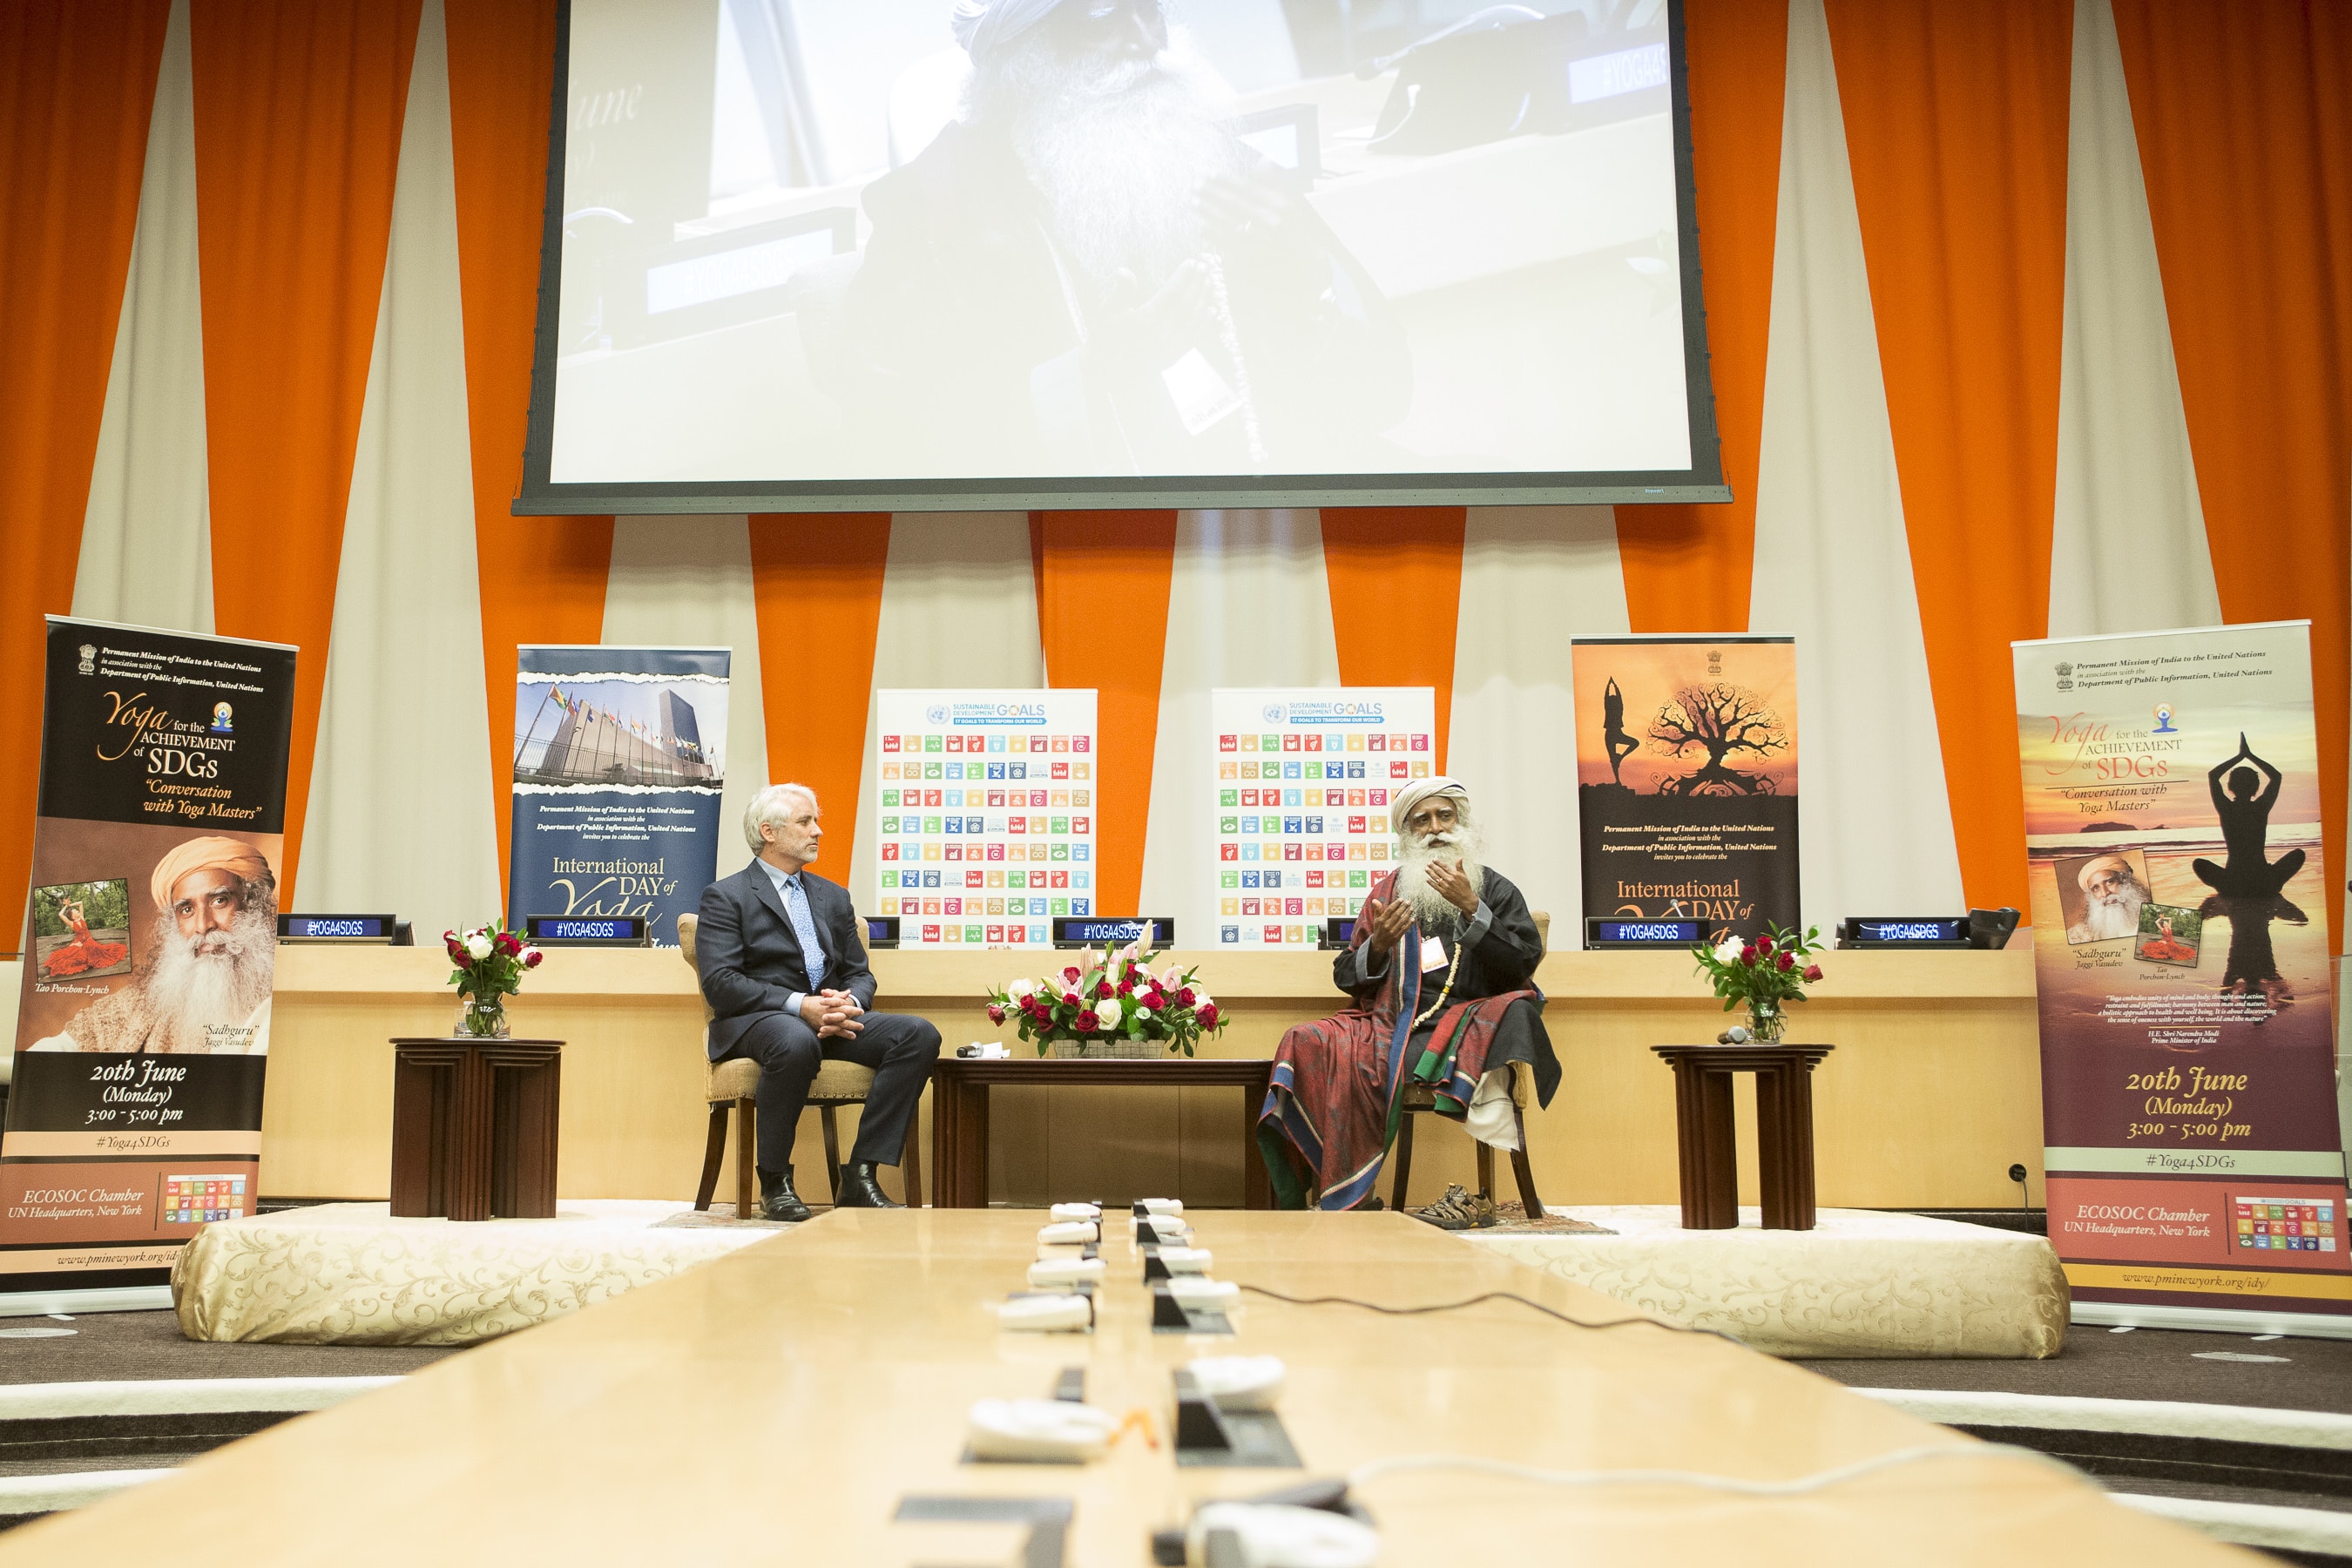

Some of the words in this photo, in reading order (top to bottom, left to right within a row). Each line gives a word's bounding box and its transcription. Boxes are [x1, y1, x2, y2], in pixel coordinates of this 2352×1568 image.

[576, 84, 641, 131] une
[102, 647, 139, 657] Permanent
[139, 652, 166, 660] Mission
[174, 655, 194, 664] India
[235, 663, 261, 672] Nations
[100, 668, 141, 678] Department
[172, 676, 214, 687] Information,
[2078, 679, 2123, 688] Department
[2160, 673, 2210, 683] Information,
[997, 705, 1044, 716] GOALS
[1334, 703, 1382, 714] GOALS
[97, 692, 173, 760] Yoga
[174, 720, 188, 731] for
[190, 721, 204, 733] the
[140, 732, 235, 751] ACHIEVEMENT
[2045, 712, 2115, 775] Yoga
[2117, 729, 2130, 739] for
[2132, 729, 2147, 738] the
[2085, 740, 2182, 754] ACHIEVEMENT
[134, 747, 144, 757] of
[148, 748, 218, 778] SDGs
[2083, 760, 2092, 770] of
[2097, 755, 2168, 780] SDGs
[2140, 785, 2167, 795] with
[144, 800, 173, 813] with
[178, 801, 206, 819] Yoga
[2079, 802, 2103, 815] Yoga
[1673, 825, 1680, 834] of
[553, 857, 664, 875] International
[619, 877, 664, 896] DAY
[664, 880, 679, 896] of
[1618, 880, 1740, 898] International
[1692, 901, 1740, 920] DAY
[1740, 904, 1754, 919] of
[307, 921, 362, 936] #YOGA4SDGS
[557, 923, 614, 937] #YOGA4SDGS
[1085, 924, 1142, 939] #YOGA4SDGS
[1619, 925, 1678, 940] #YOGA4SDGS
[1880, 924, 1939, 939] #YOGA4SDGS
[2075, 960, 2093, 970] Jaggi
[35, 983, 49, 992] Tao
[51, 984, 109, 995] Porchon-Lynch
[203, 1037, 221, 1047] Jaggi
[91, 1059, 133, 1080] 20th
[135, 1060, 186, 1087] June
[2126, 1066, 2181, 1091] 20th
[2184, 1066, 2247, 1098] June
[103, 1086, 172, 1106] (Monday)
[2145, 1096, 2233, 1120] (Monday)
[85, 1110, 115, 1124] 3:00
[128, 1110, 156, 1125] 5:00
[159, 1109, 183, 1125] pm
[2126, 1123, 2164, 1139] 3:00
[2181, 1123, 2217, 1139] 5:00
[2220, 1123, 2251, 1141] pm
[97, 1136, 170, 1150] #Yoga4SDGs
[2146, 1154, 2235, 1170] #Yoga4SDGs
[23, 1189, 87, 1204] ECOSOC
[89, 1188, 143, 1202] Chamber
[9, 1207, 28, 1218] UN
[30, 1207, 94, 1220] Headquarters,
[97, 1206, 119, 1216] New
[121, 1206, 142, 1215] York
[2077, 1206, 2145, 1220] ECOSOC
[2147, 1207, 2209, 1222] Chamber
[2065, 1221, 2084, 1232] UN
[2085, 1221, 2156, 1236] Headquarters,
[2159, 1226, 2183, 1236] New
[2186, 1226, 2210, 1237] York
[57, 1251, 178, 1266] www.pminewyork.org/id
[2123, 1274, 2270, 1289] www.pminewyork.org/idy/
